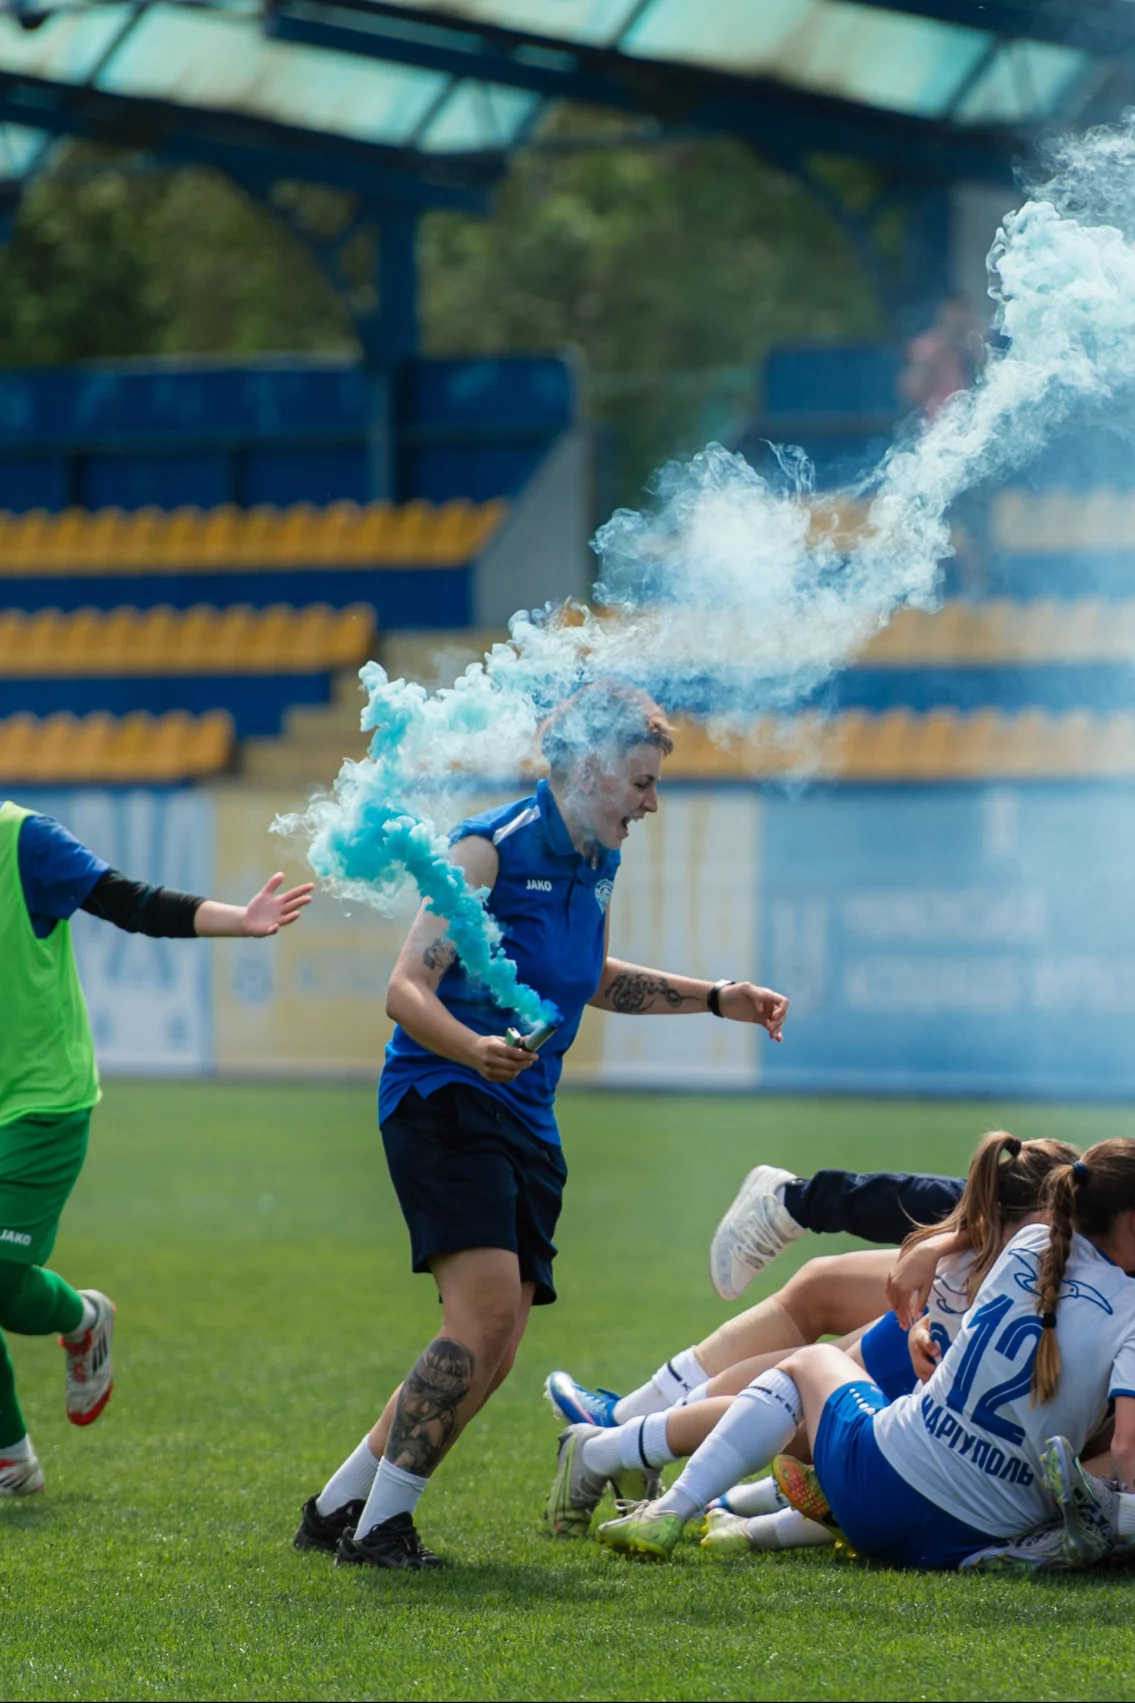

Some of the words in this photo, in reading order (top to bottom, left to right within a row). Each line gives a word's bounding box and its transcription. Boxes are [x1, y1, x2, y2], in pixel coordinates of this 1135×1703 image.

[526, 878, 552, 892] JAKO
[0, 1229, 32, 1247] JAKO
[946, 1294, 1044, 1447] 12
